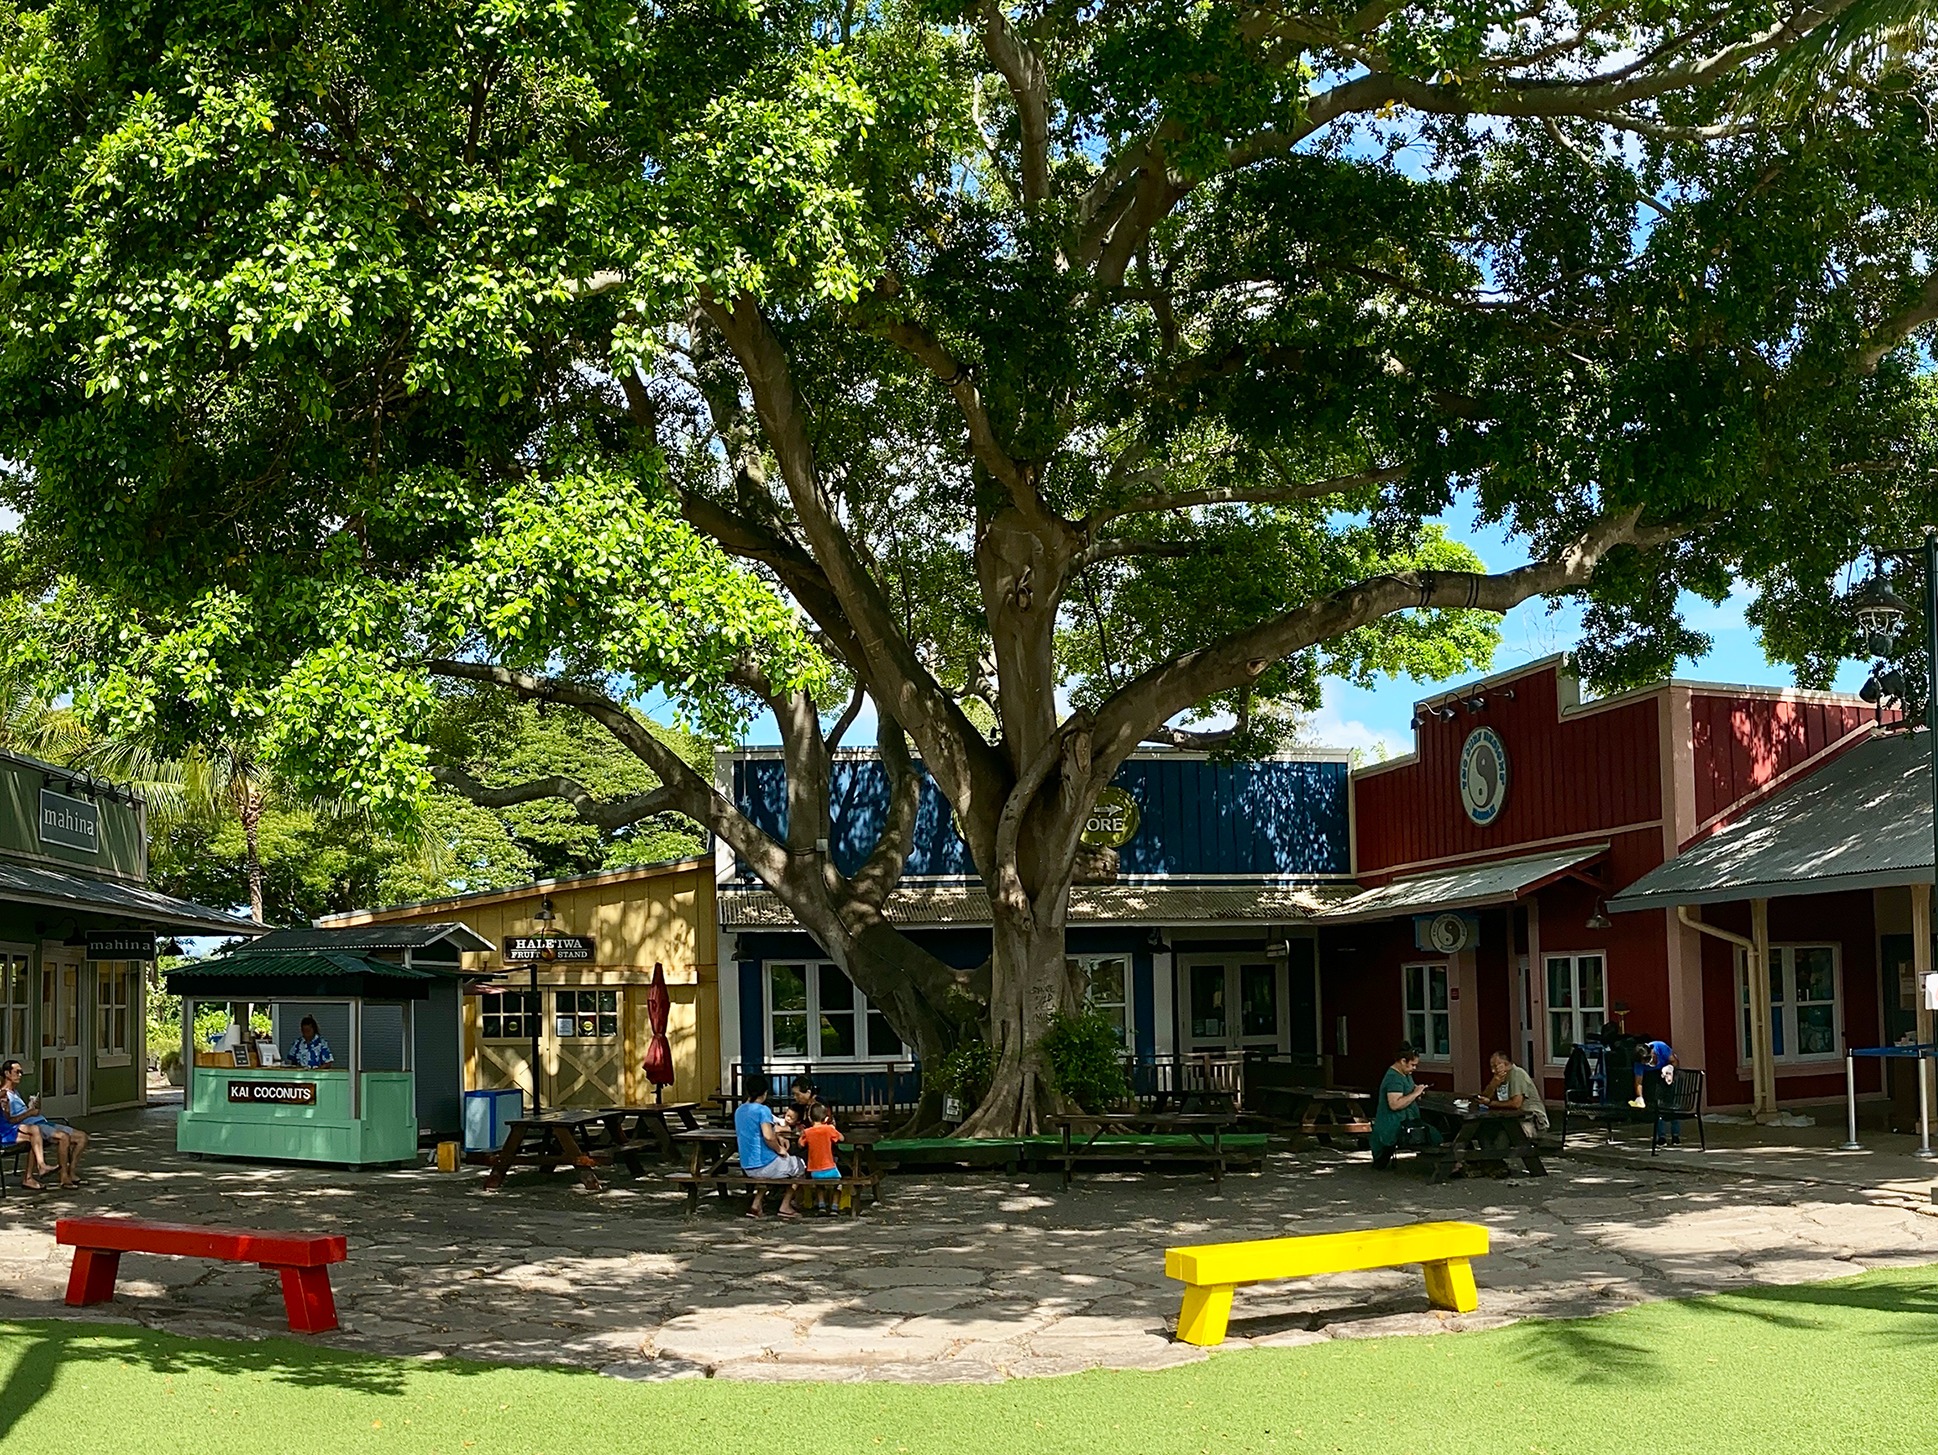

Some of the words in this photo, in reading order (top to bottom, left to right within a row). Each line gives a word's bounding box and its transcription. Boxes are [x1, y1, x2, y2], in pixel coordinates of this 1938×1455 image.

[44, 808, 95, 836] mahina
[1085, 817, 1124, 832] ORE
[90, 939, 151, 951] mahina
[510, 951, 541, 959] FRUIT
[557, 951, 588, 959] STAND
[231, 1086, 250, 1098] KAI
[253, 1086, 312, 1101] COCONUTS
